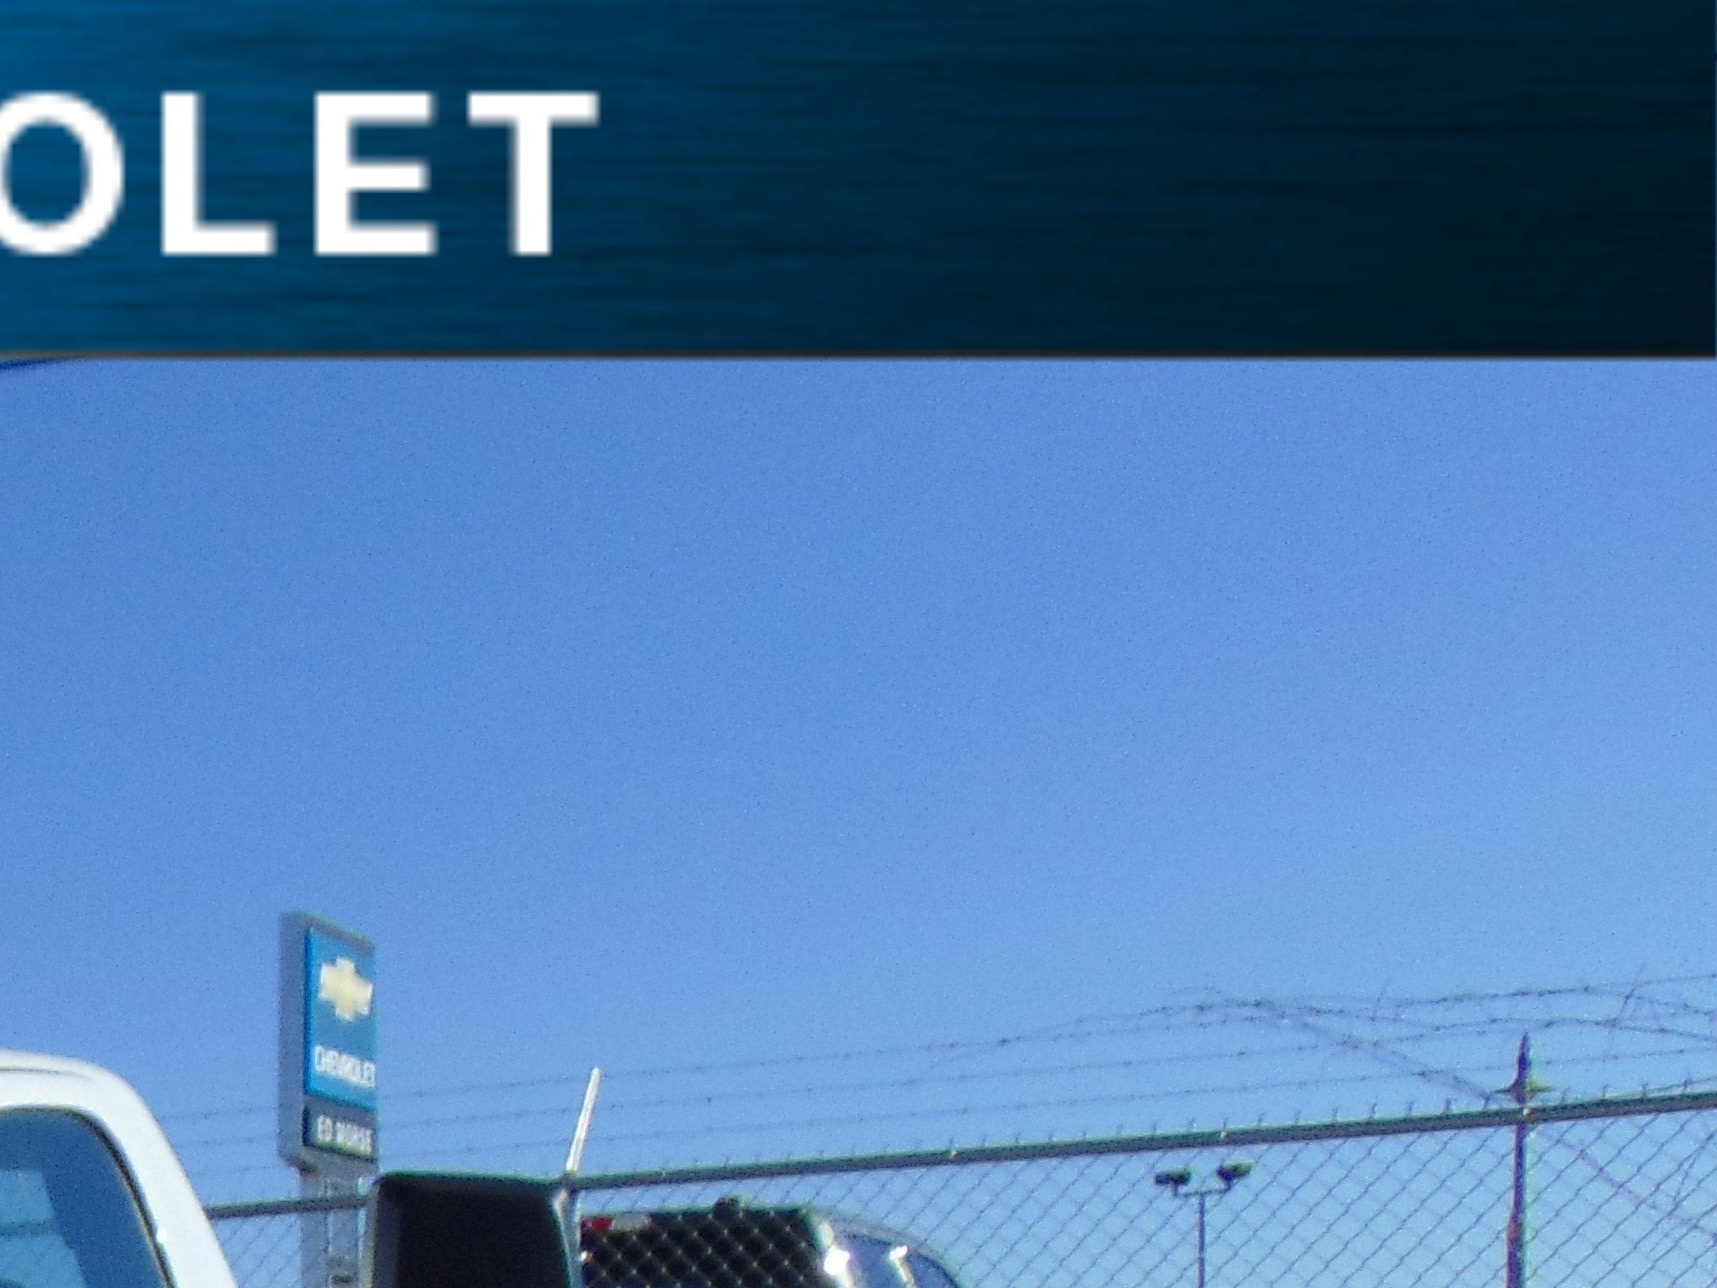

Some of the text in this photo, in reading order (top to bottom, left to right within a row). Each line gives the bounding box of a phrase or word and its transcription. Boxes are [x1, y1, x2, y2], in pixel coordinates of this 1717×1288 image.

[314, 1045, 376, 1089] CHEVROLET
[317, 1114, 374, 1156] ED MORSE
